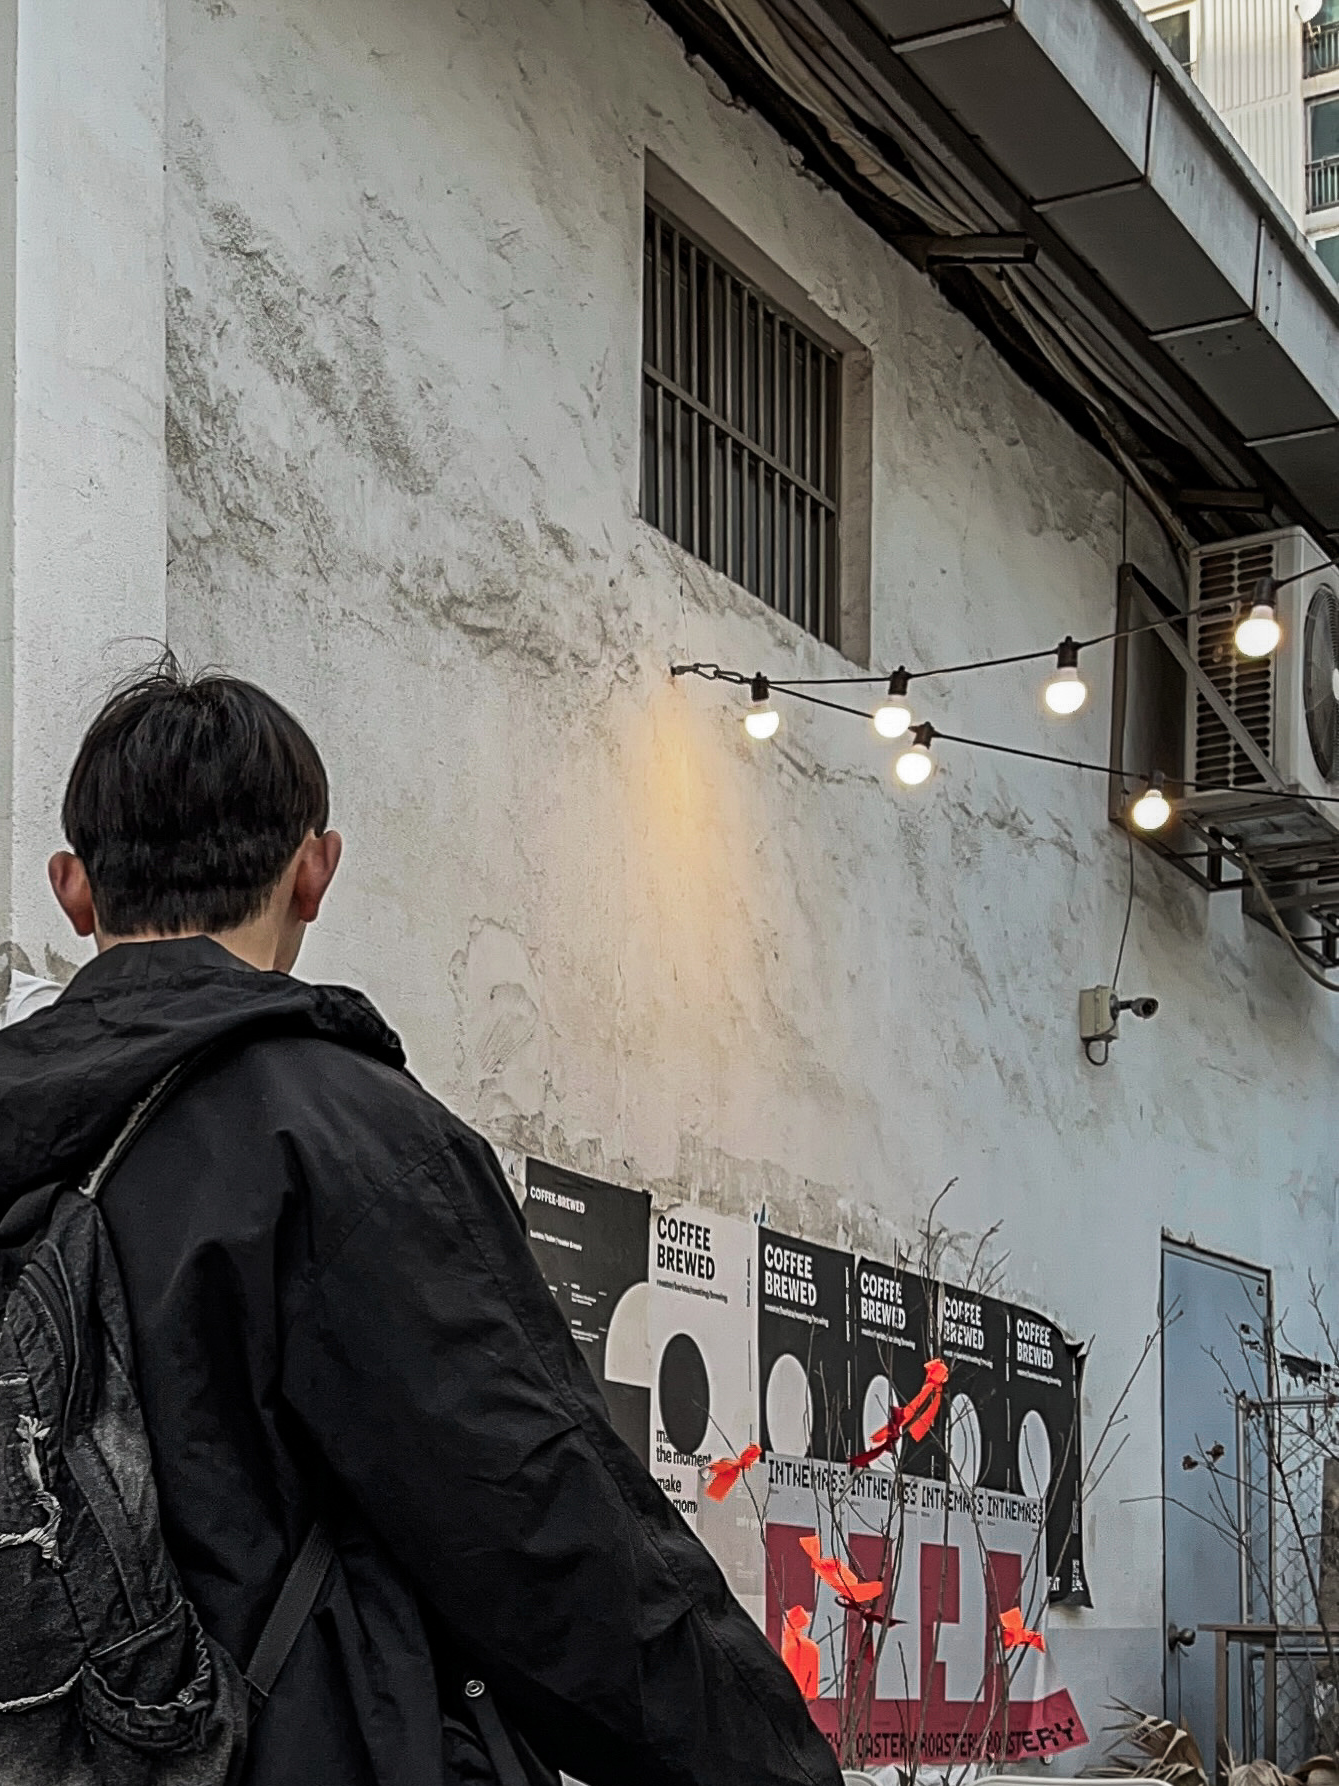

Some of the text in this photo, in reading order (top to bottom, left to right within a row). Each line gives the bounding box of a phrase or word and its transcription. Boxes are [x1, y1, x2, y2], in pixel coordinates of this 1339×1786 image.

[657, 1214, 711, 1252] COFFEE
[657, 1243, 715, 1280] BREWED
[764, 1243, 813, 1280] COFFEE
[764, 1270, 817, 1307] BREWED
[860, 1271, 903, 1305] COFFEE
[943, 1296, 982, 1327] COFFEE
[943, 1320, 985, 1351] BREWED
[1016, 1318, 1052, 1348] COFFEE
[1016, 1340, 1054, 1370] BREWED
[656, 1445, 672, 1463] the
